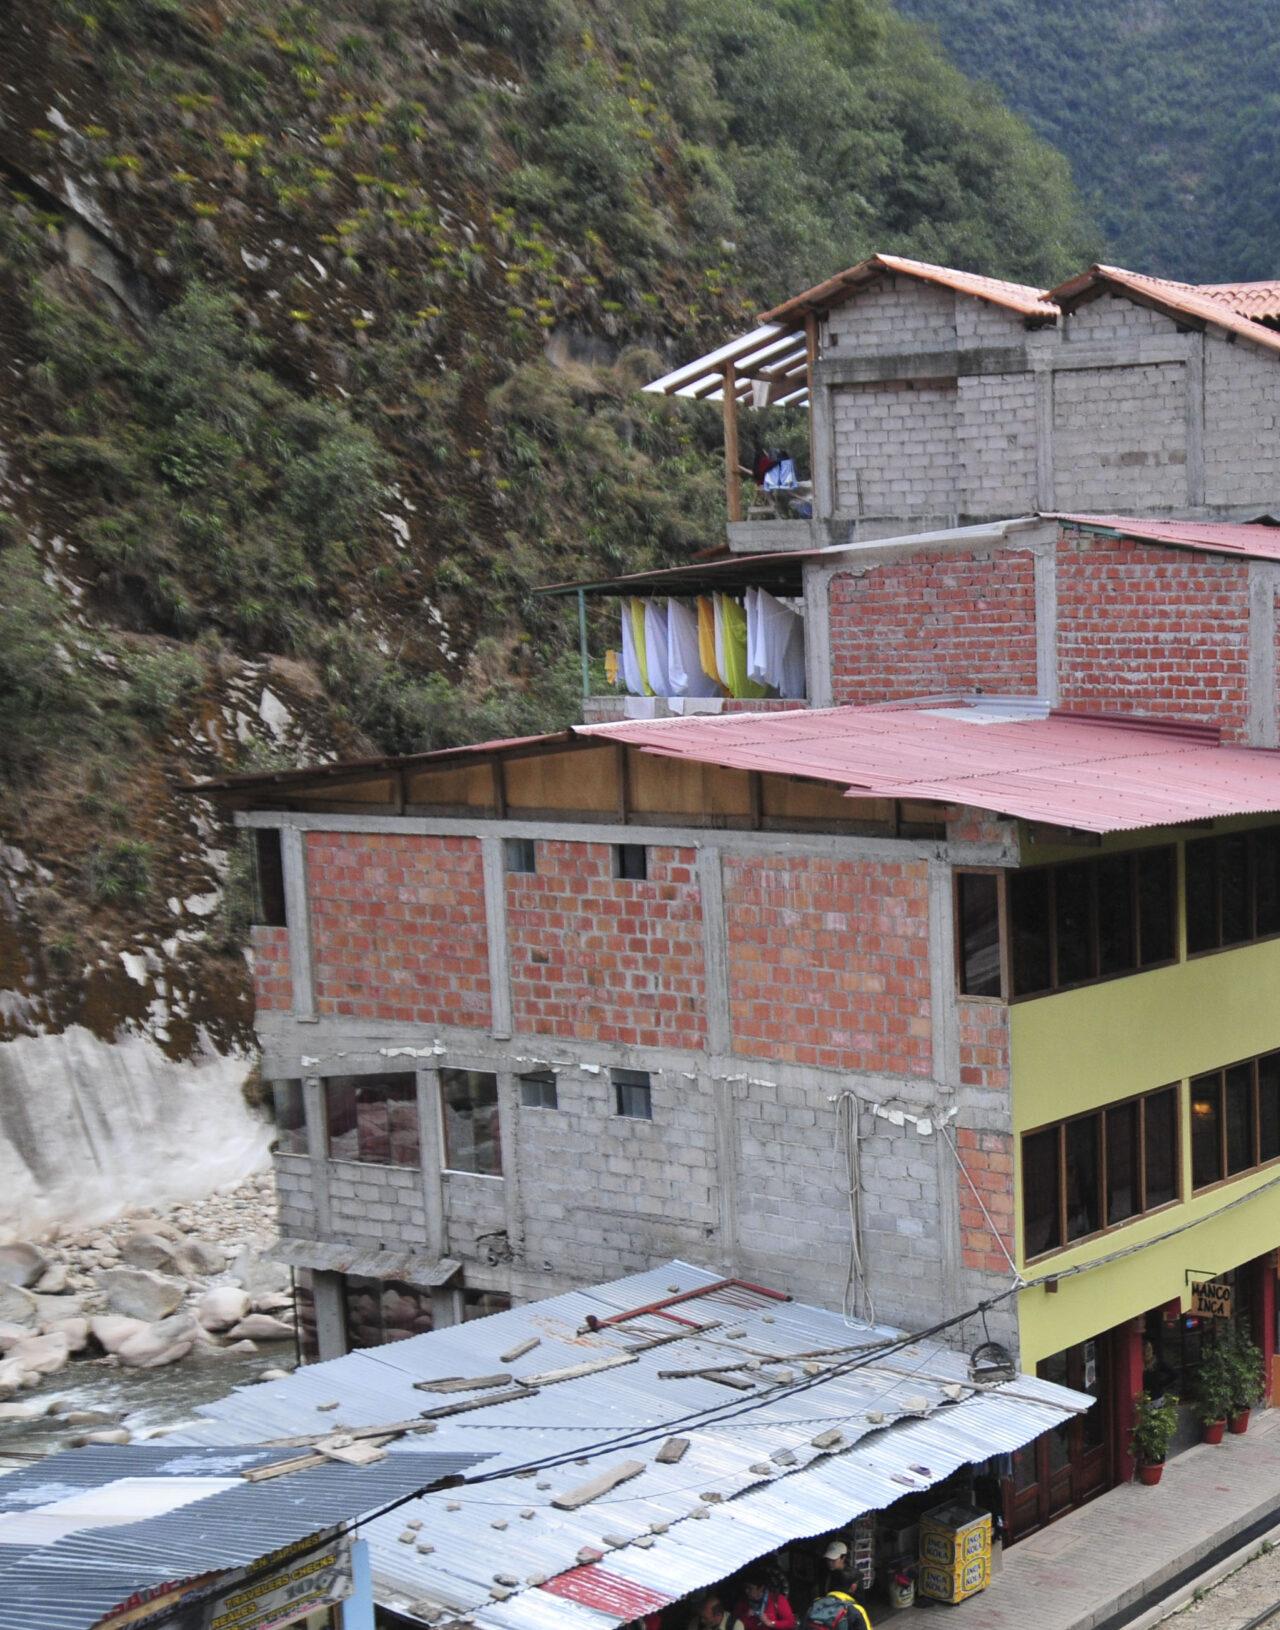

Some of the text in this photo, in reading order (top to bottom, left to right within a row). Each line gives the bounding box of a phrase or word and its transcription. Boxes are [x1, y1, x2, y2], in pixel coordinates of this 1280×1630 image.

[1191, 1282, 1230, 1301] MANCO
[1198, 1297, 1224, 1315] INCA
[290, 1553, 337, 1581] CHECKS
